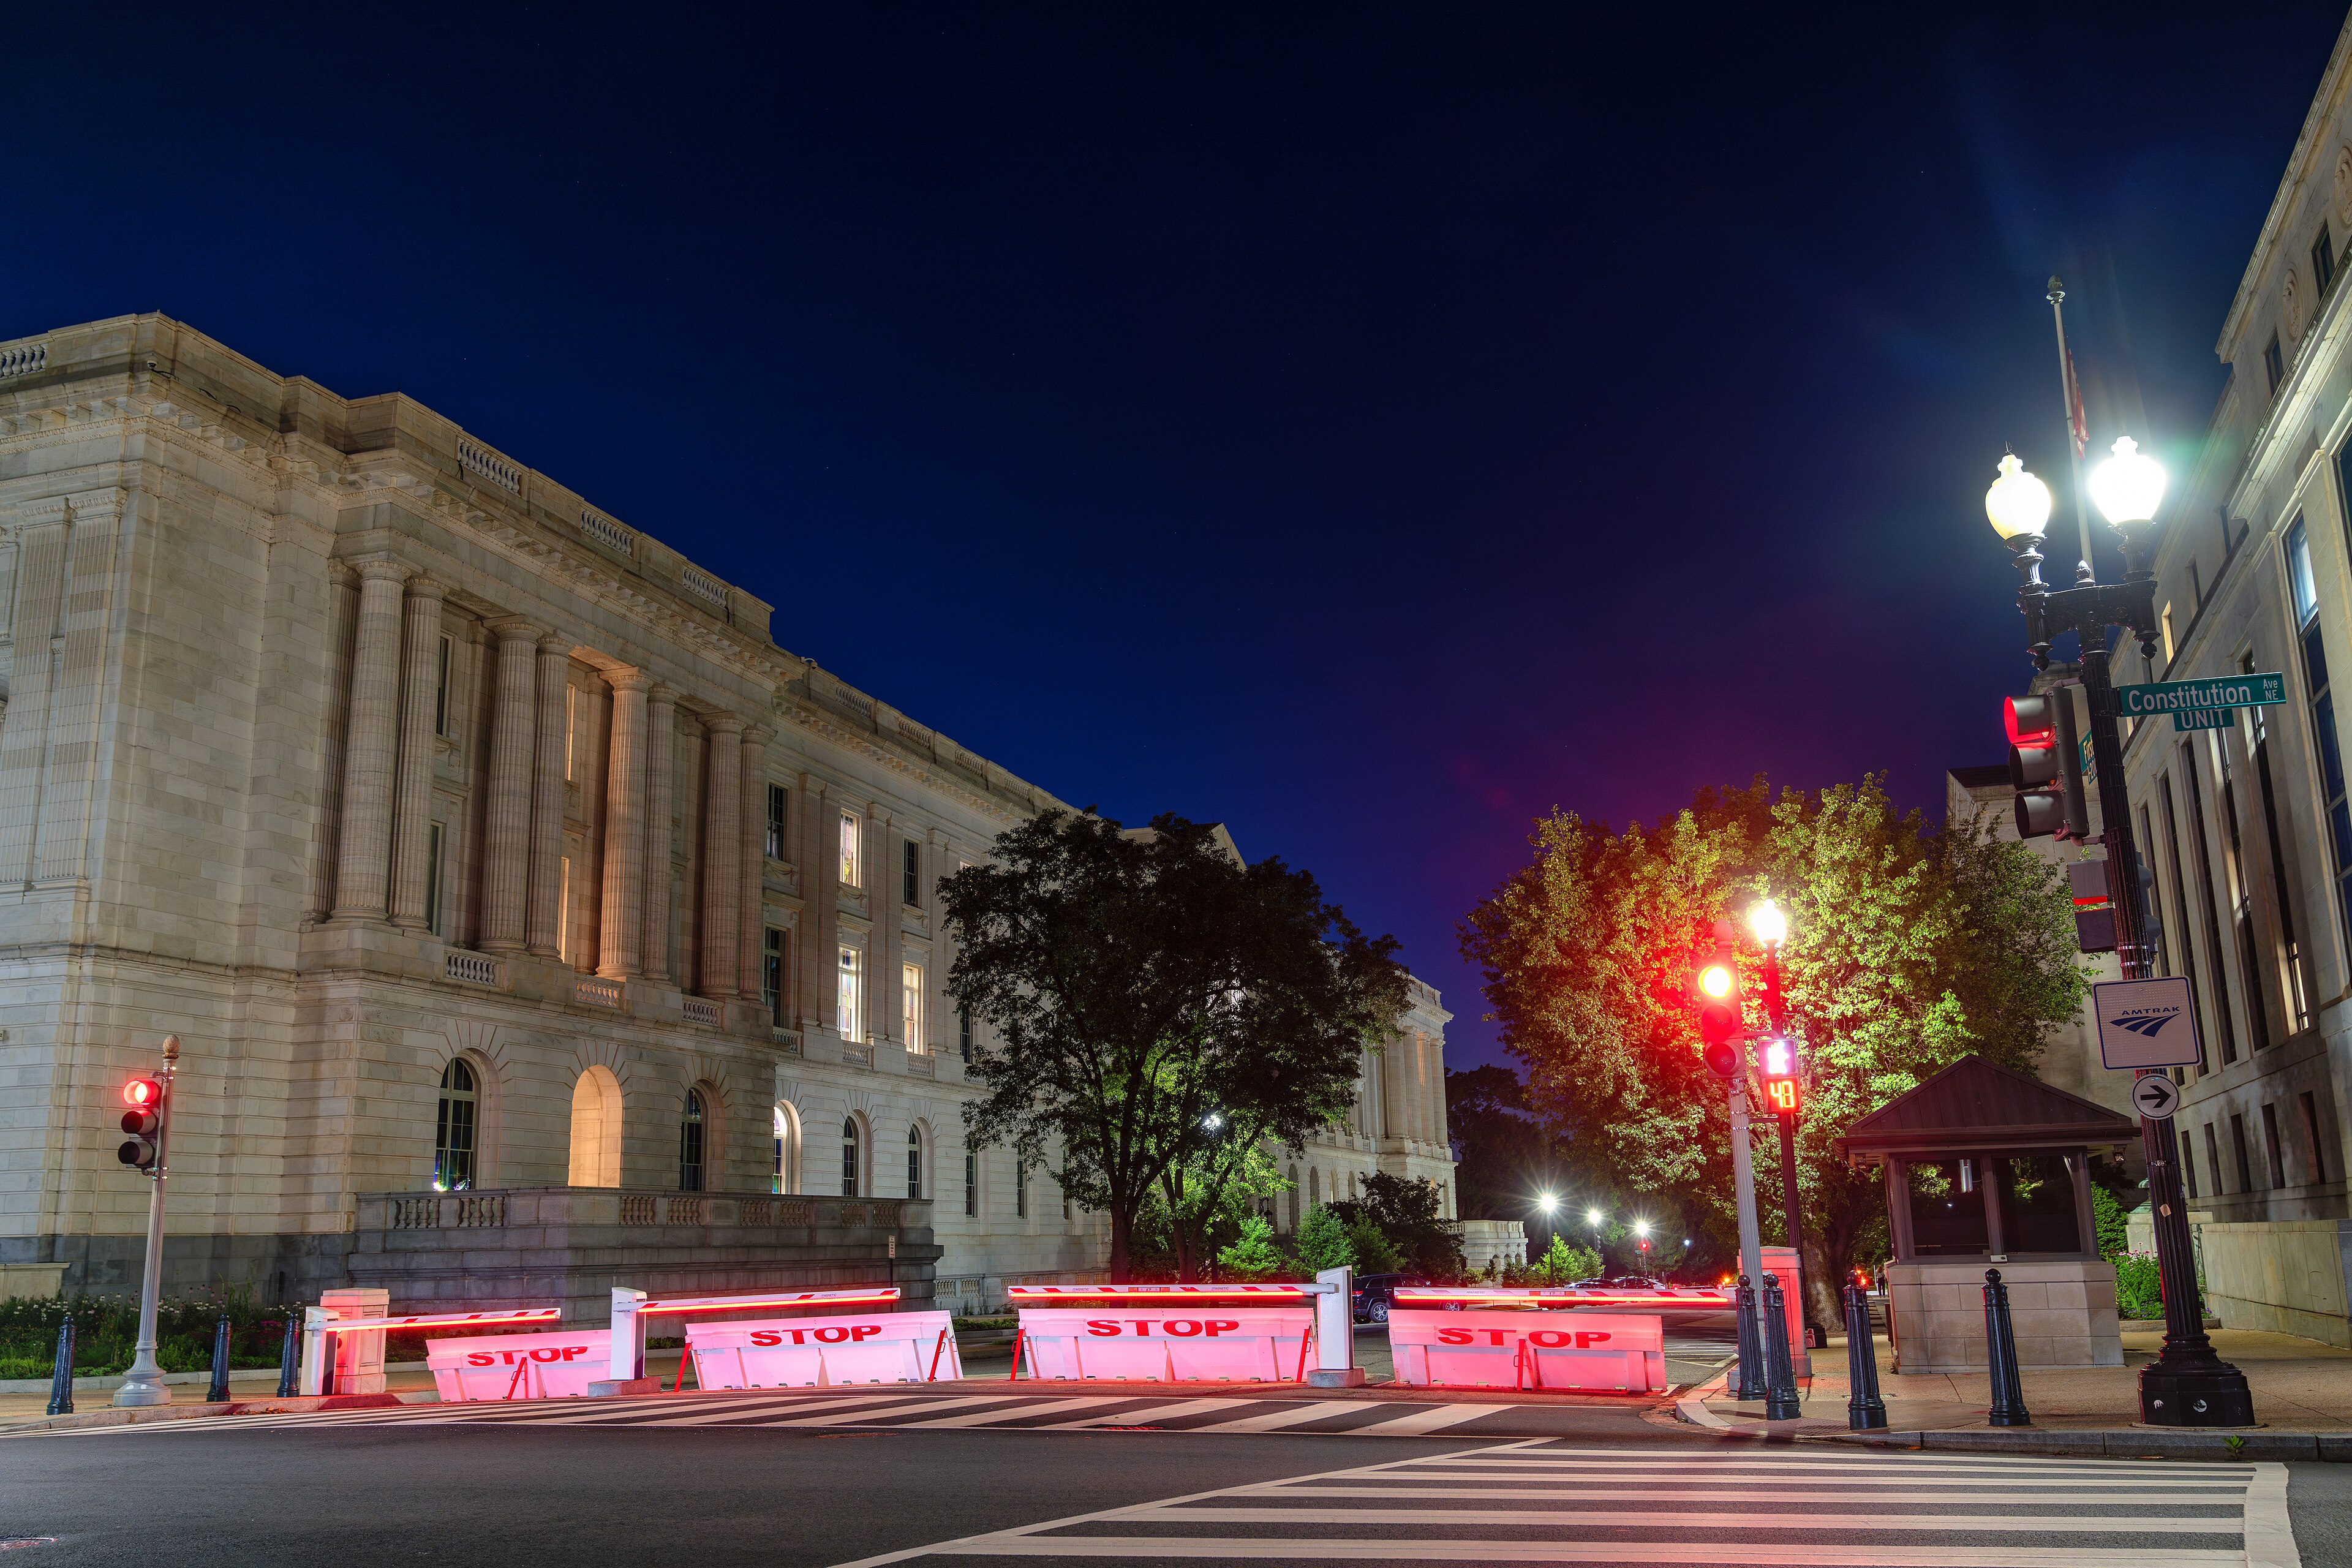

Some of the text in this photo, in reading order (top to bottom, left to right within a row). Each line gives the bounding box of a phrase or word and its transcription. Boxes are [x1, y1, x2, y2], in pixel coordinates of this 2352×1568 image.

[2128, 678, 2278, 712] Constitution Ave
[2265, 690, 2278, 701] NE
[2180, 709, 2225, 729] UNIT
[2083, 734, 2094, 764] First
[2121, 1006, 2180, 1016] AMTRAK
[750, 1325, 882, 1347] STOP
[1087, 1319, 1239, 1337] STOP
[1438, 1327, 1611, 1349] STOP
[467, 1346, 589, 1366] STOP
